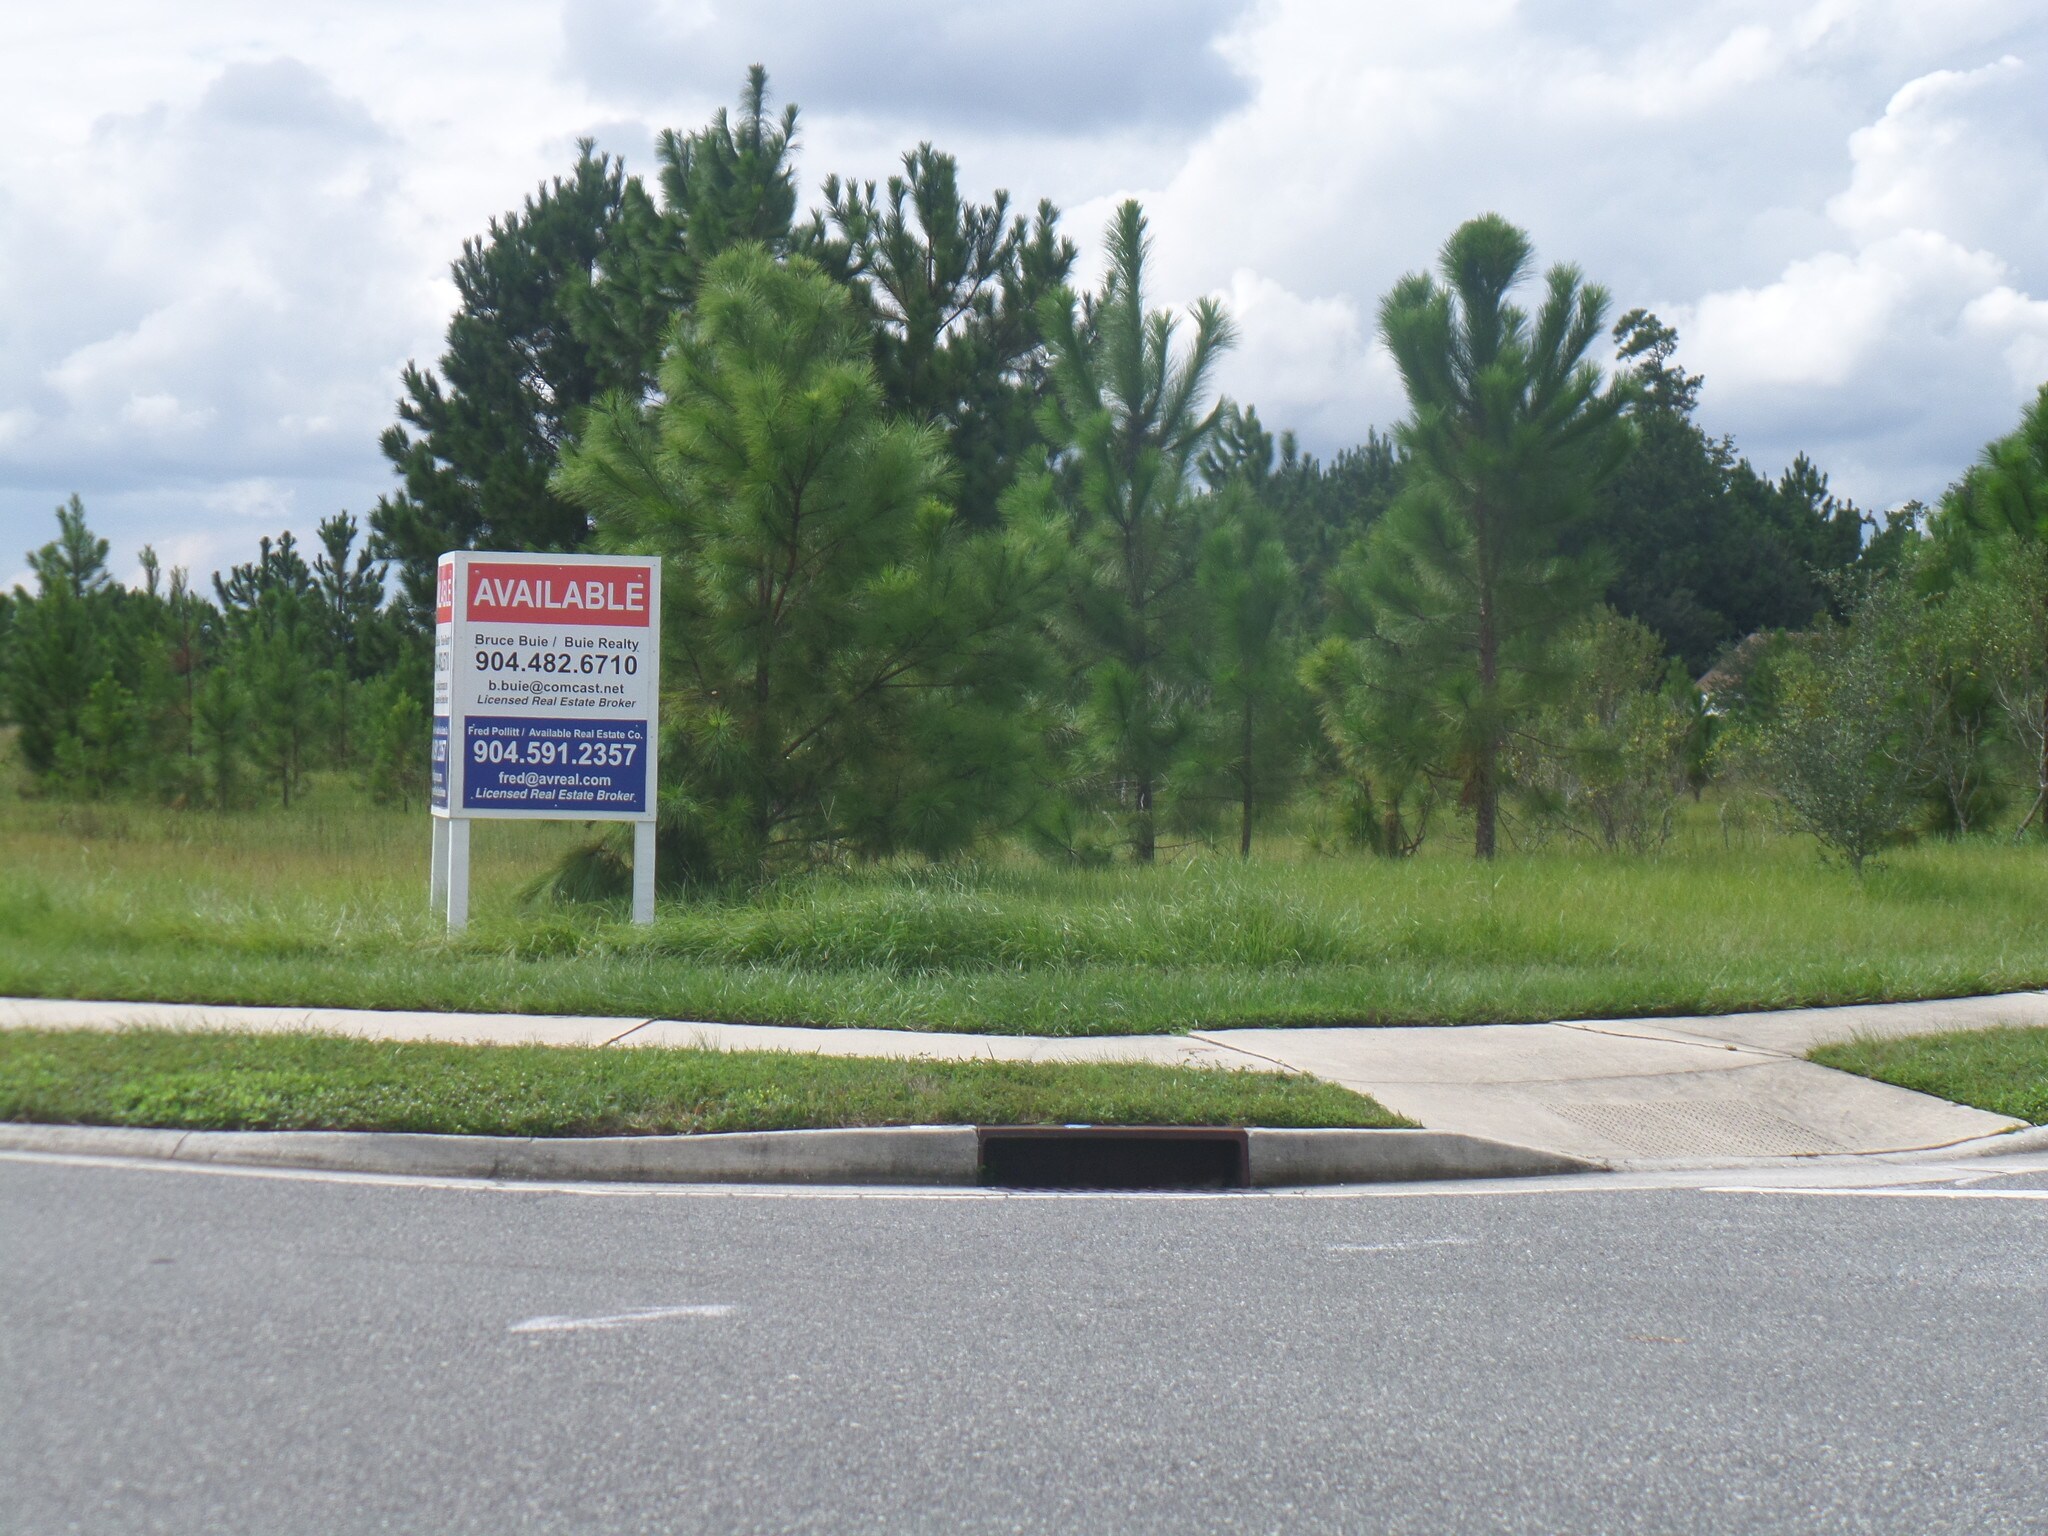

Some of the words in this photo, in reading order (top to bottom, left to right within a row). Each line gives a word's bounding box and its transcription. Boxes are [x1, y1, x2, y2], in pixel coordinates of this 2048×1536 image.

[473, 578, 644, 611] AVAILABLE
[475, 633, 514, 646] Bruce
[519, 635, 548, 647] Buie
[552, 636, 557, 647] /
[564, 637, 594, 648] Buie
[598, 638, 639, 651] Realty
[475, 651, 638, 675] 904.482.6710
[488, 680, 624, 694] b.buie@comcast.net
[477, 694, 528, 705] Licensed
[531, 695, 556, 706] Real
[560, 697, 596, 707] Estate
[598, 698, 636, 708] Broker
[468, 725, 490, 736] Fred
[492, 726, 520, 737] Pollitt
[521, 727, 525, 737] /
[528, 728, 572, 738] Available
[573, 729, 594, 739] Real
[596, 729, 625, 740] Estate
[627, 730, 643, 740] Co.
[473, 739, 637, 766] 904.591.2357
[498, 772, 611, 788] fred@avreal.com
[475, 788, 528, 800] Licensed
[530, 789, 555, 800] Real
[558, 790, 594, 801] Estate
[597, 790, 635, 801] Broker
